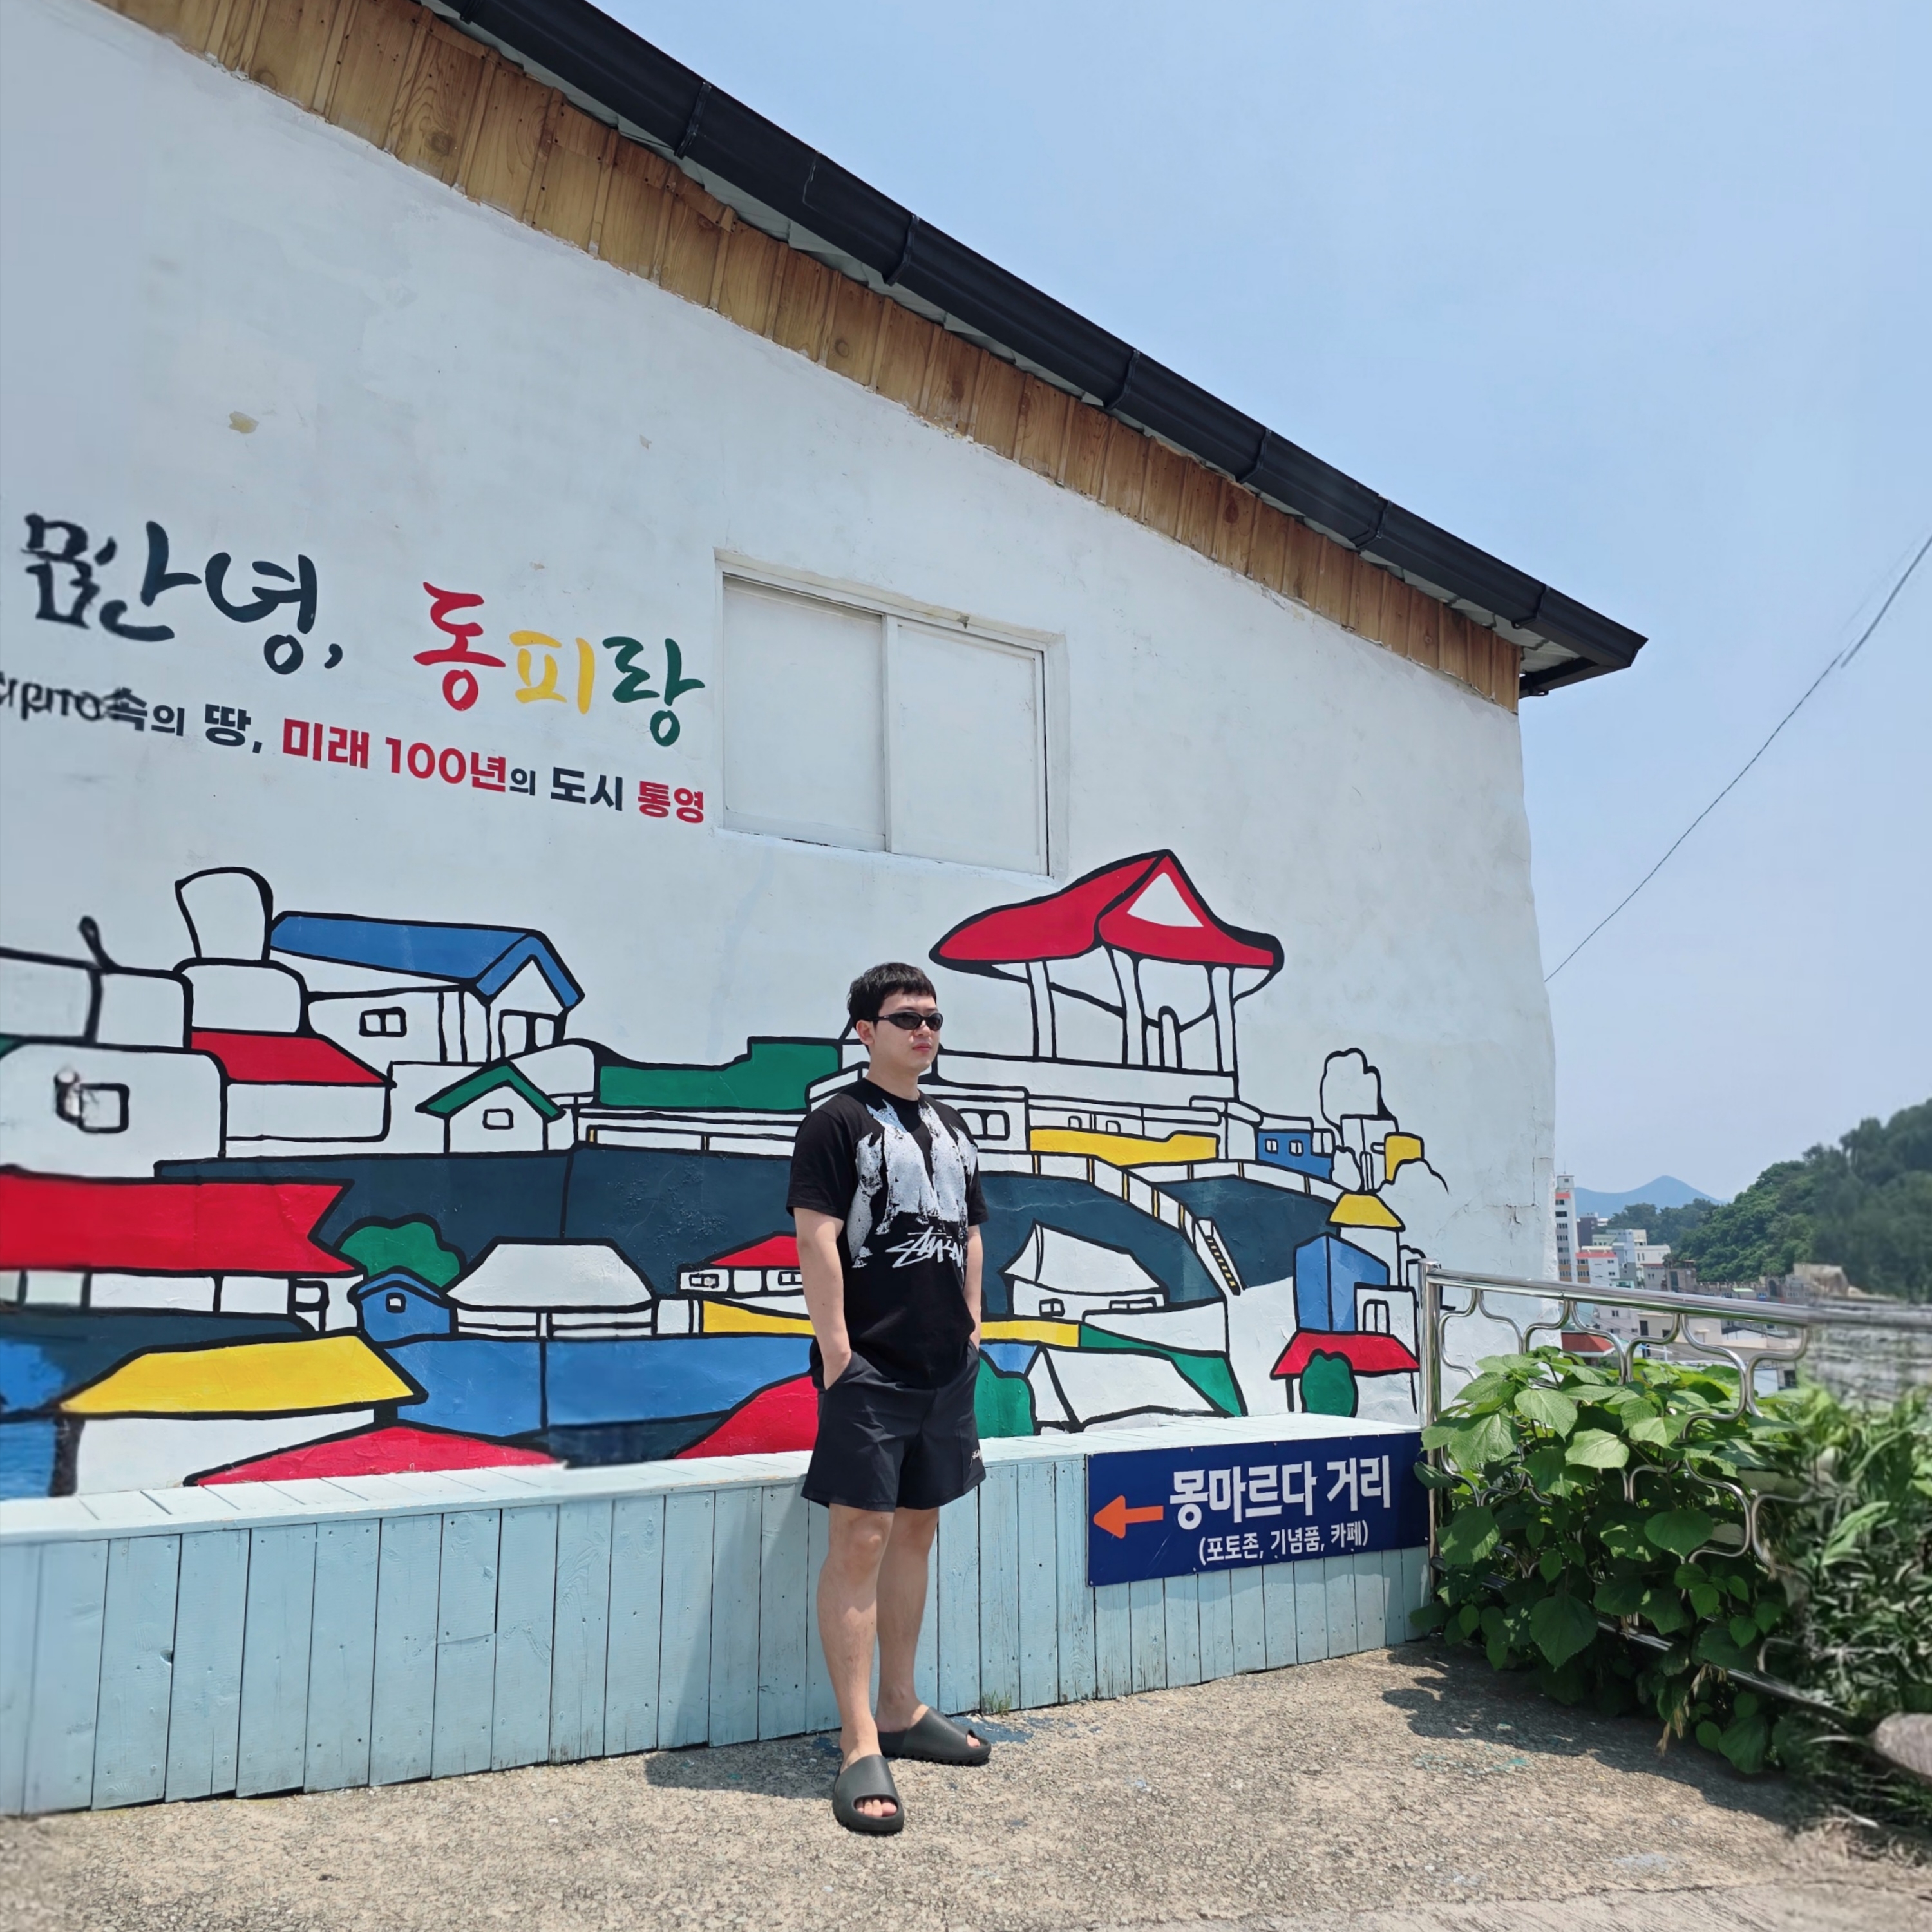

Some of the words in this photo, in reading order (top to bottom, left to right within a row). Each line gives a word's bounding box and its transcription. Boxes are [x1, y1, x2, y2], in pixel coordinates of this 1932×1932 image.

[413, 582, 705, 747] 동피랑
[205, 703, 262, 753] 땅,
[283, 717, 370, 770] 미래
[386, 737, 536, 797] 100년의
[551, 766, 623, 811] 도시
[638, 780, 704, 824] 통영
[1169, 1460, 1318, 1531] 몽마르다
[1327, 1454, 1391, 1513] 거리
[1199, 1536, 1264, 1566] (포토존,
[1271, 1526, 1325, 1555] 기념품,
[1331, 1519, 1369, 1548] 카페)
